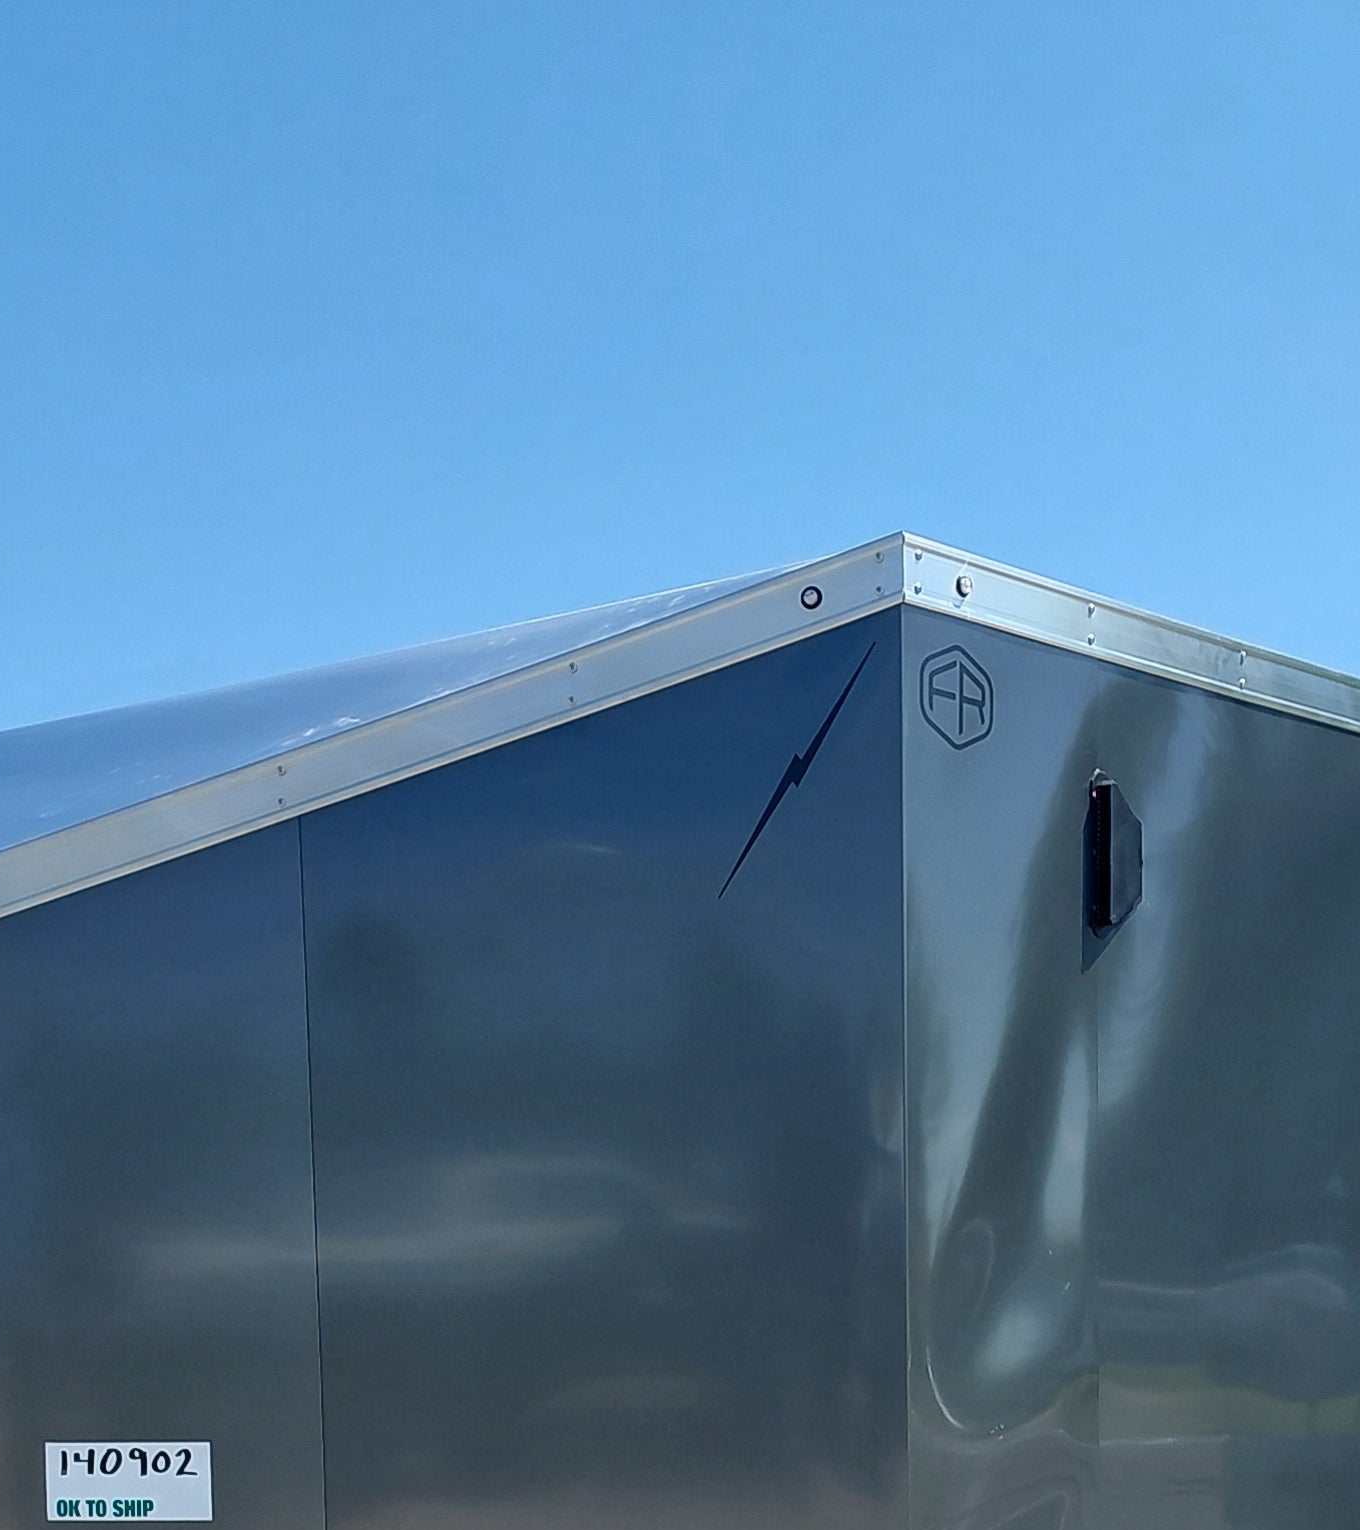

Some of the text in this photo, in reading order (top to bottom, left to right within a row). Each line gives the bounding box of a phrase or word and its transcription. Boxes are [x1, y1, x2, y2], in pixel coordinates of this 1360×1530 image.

[60, 1447, 198, 1477] 140902
[56, 1499, 154, 1518] OK TO SHIP
